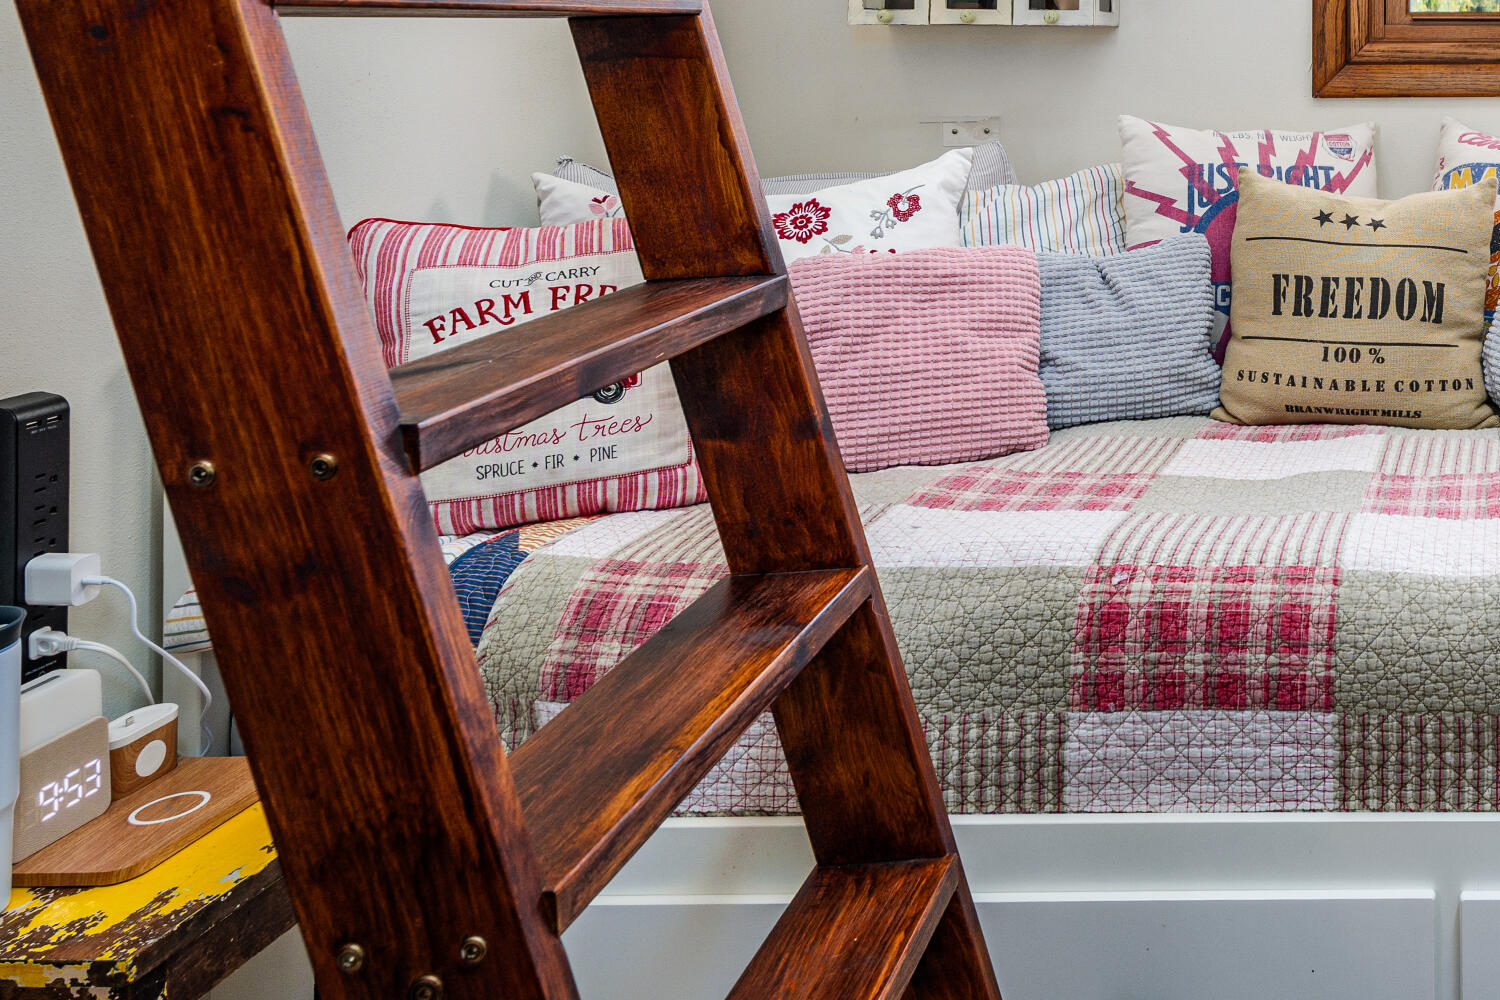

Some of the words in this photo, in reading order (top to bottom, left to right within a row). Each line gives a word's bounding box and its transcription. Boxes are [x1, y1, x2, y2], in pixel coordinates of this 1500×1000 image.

[489, 278, 524, 289] CUT
[545, 265, 601, 282] CARRY
[1271, 273, 1446, 324] FREEDOM
[423, 290, 534, 345] FARM
[1237, 369, 1386, 393] SUSTAINABLE
[1394, 378, 1474, 393] COTTON
[463, 428, 567, 457] istmas
[570, 413, 653, 442] trees
[475, 459, 526, 480] SPRUCE
[544, 453, 565, 470] FIR
[589, 444, 618, 462] PINE
[38, 758, 101, 822] 9:53
